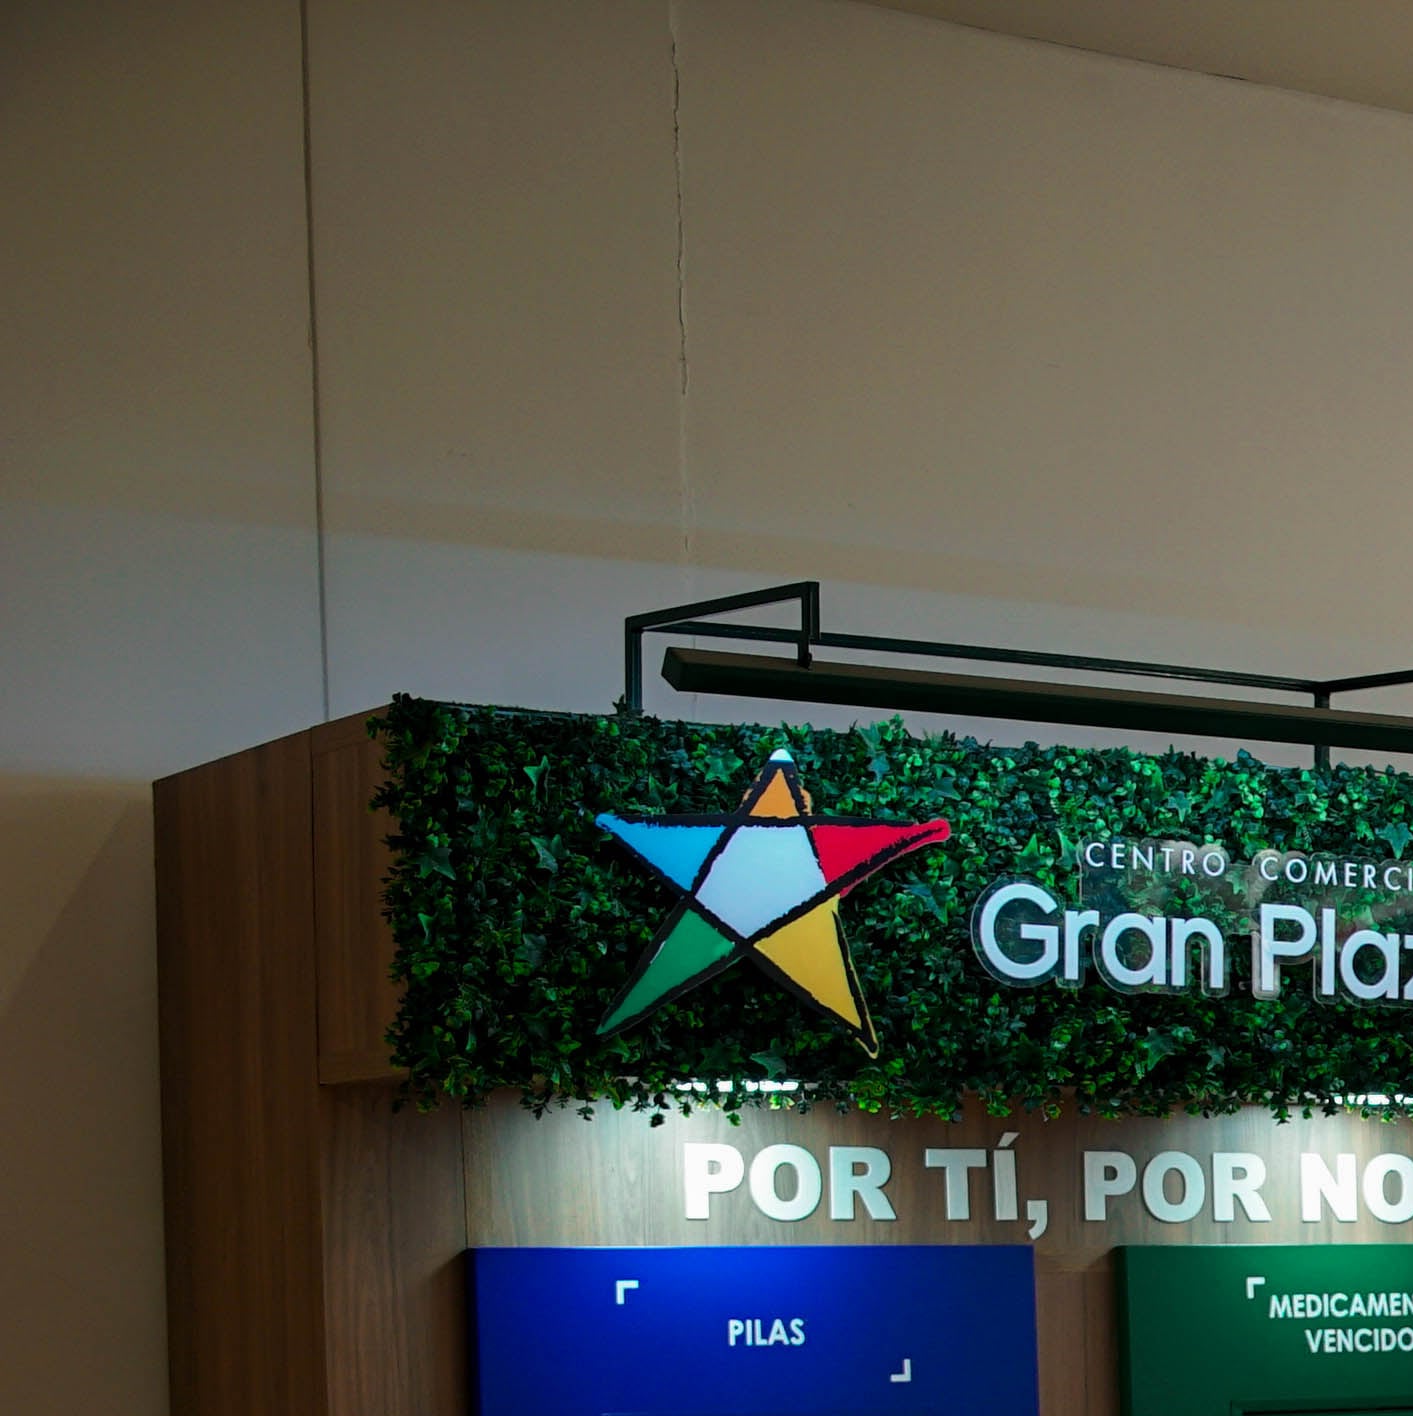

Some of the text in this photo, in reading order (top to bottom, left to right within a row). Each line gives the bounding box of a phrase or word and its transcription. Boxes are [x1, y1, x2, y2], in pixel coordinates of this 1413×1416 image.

[1083, 841, 1228, 879] CENTRO
[978, 882, 1225, 989] Gran
[684, 1142, 897, 1222] POR
[924, 1131, 1049, 1239] TÍ,
[1083, 1150, 1270, 1222] POR
[727, 1317, 806, 1347] PILAS
